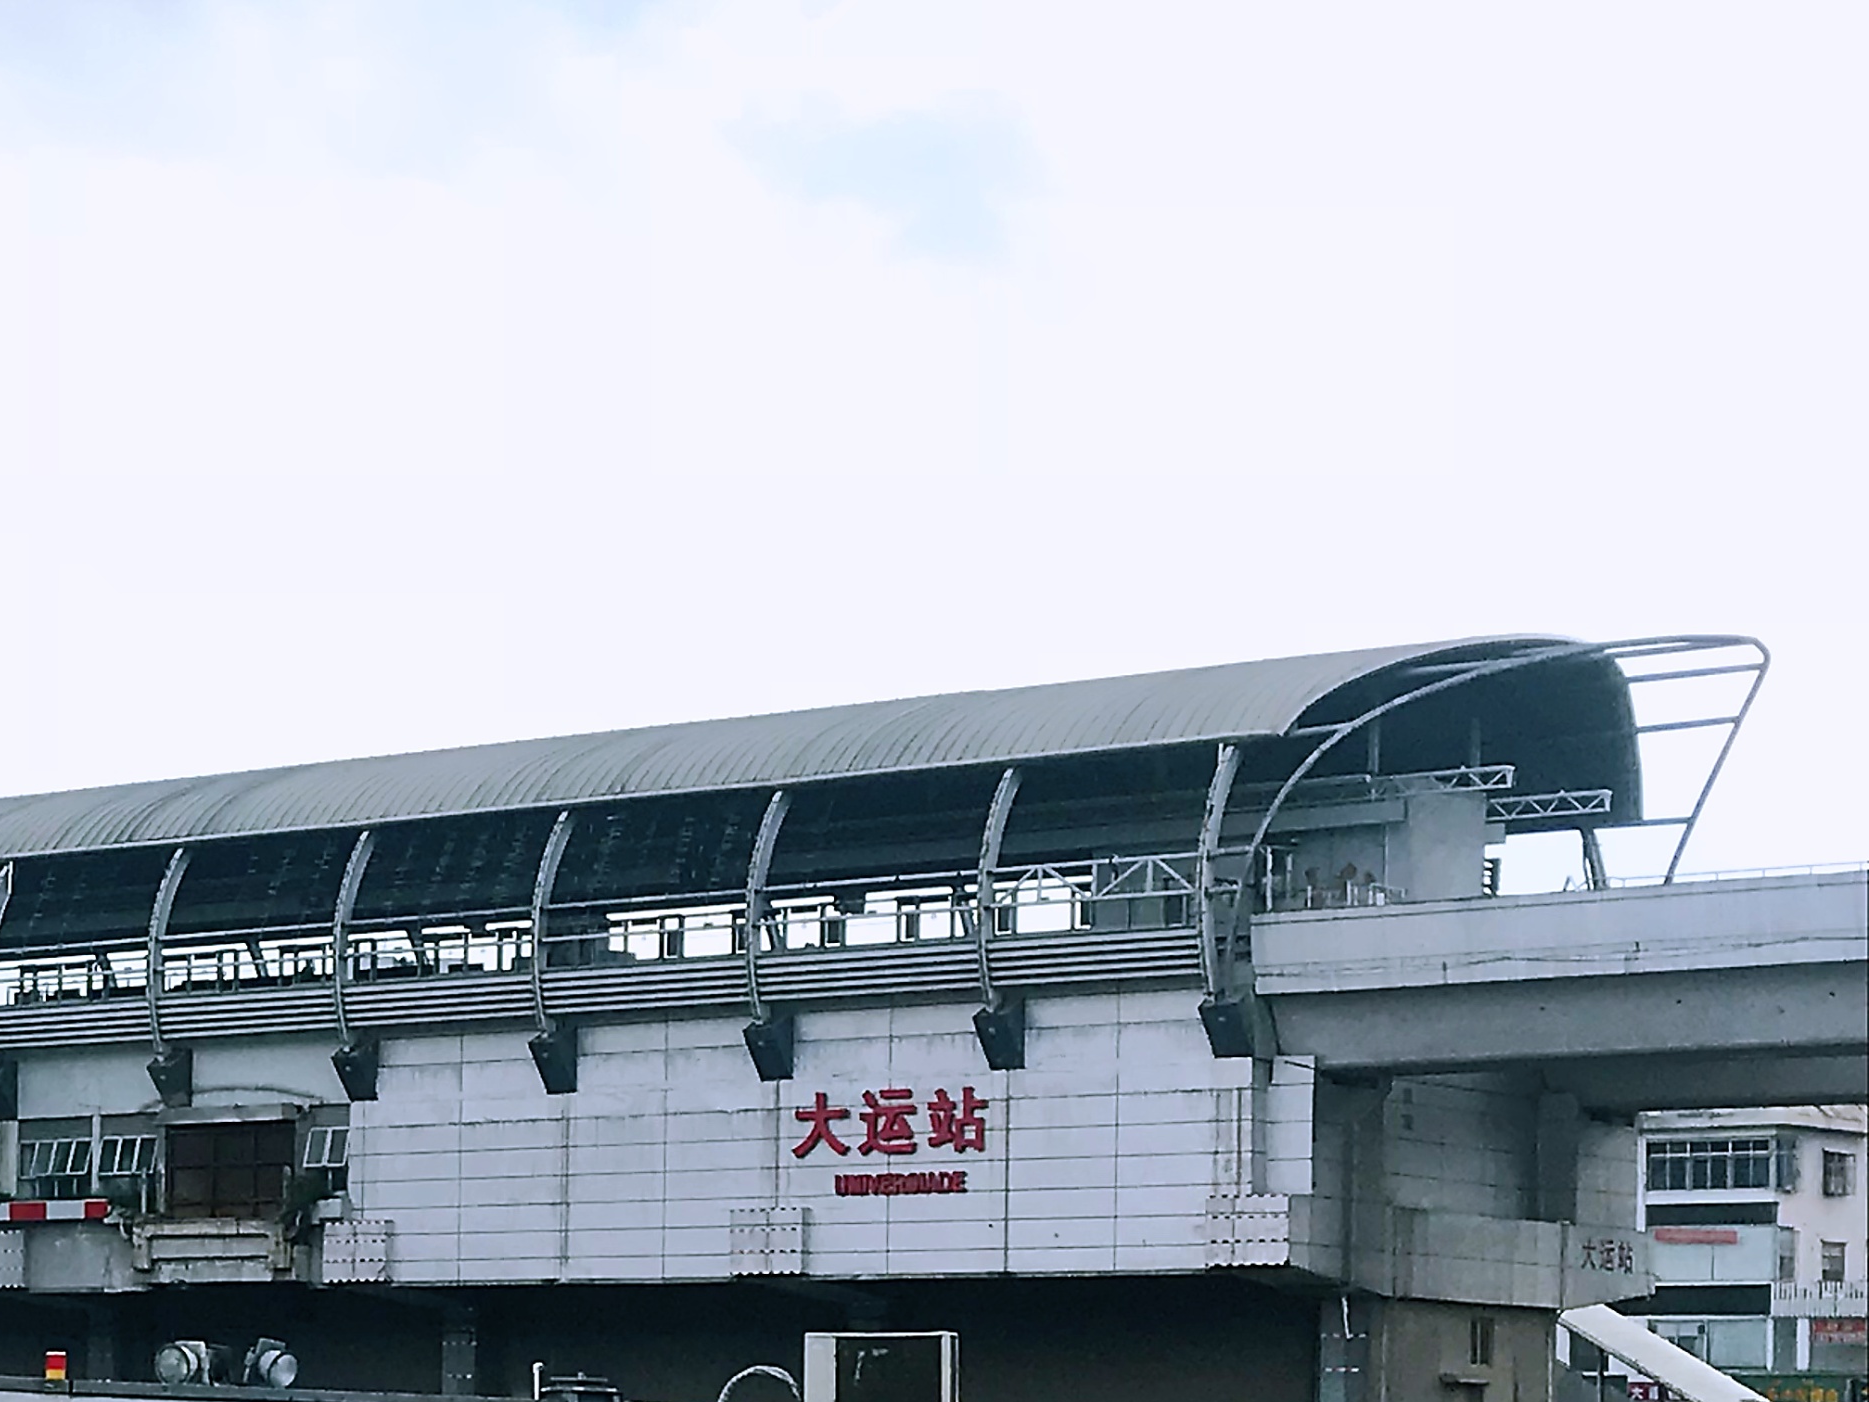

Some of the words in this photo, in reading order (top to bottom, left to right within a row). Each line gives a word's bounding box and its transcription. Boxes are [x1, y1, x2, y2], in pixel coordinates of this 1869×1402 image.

[791, 1086, 989, 1159] 大运站
[1581, 1237, 1633, 1274] 大运站
